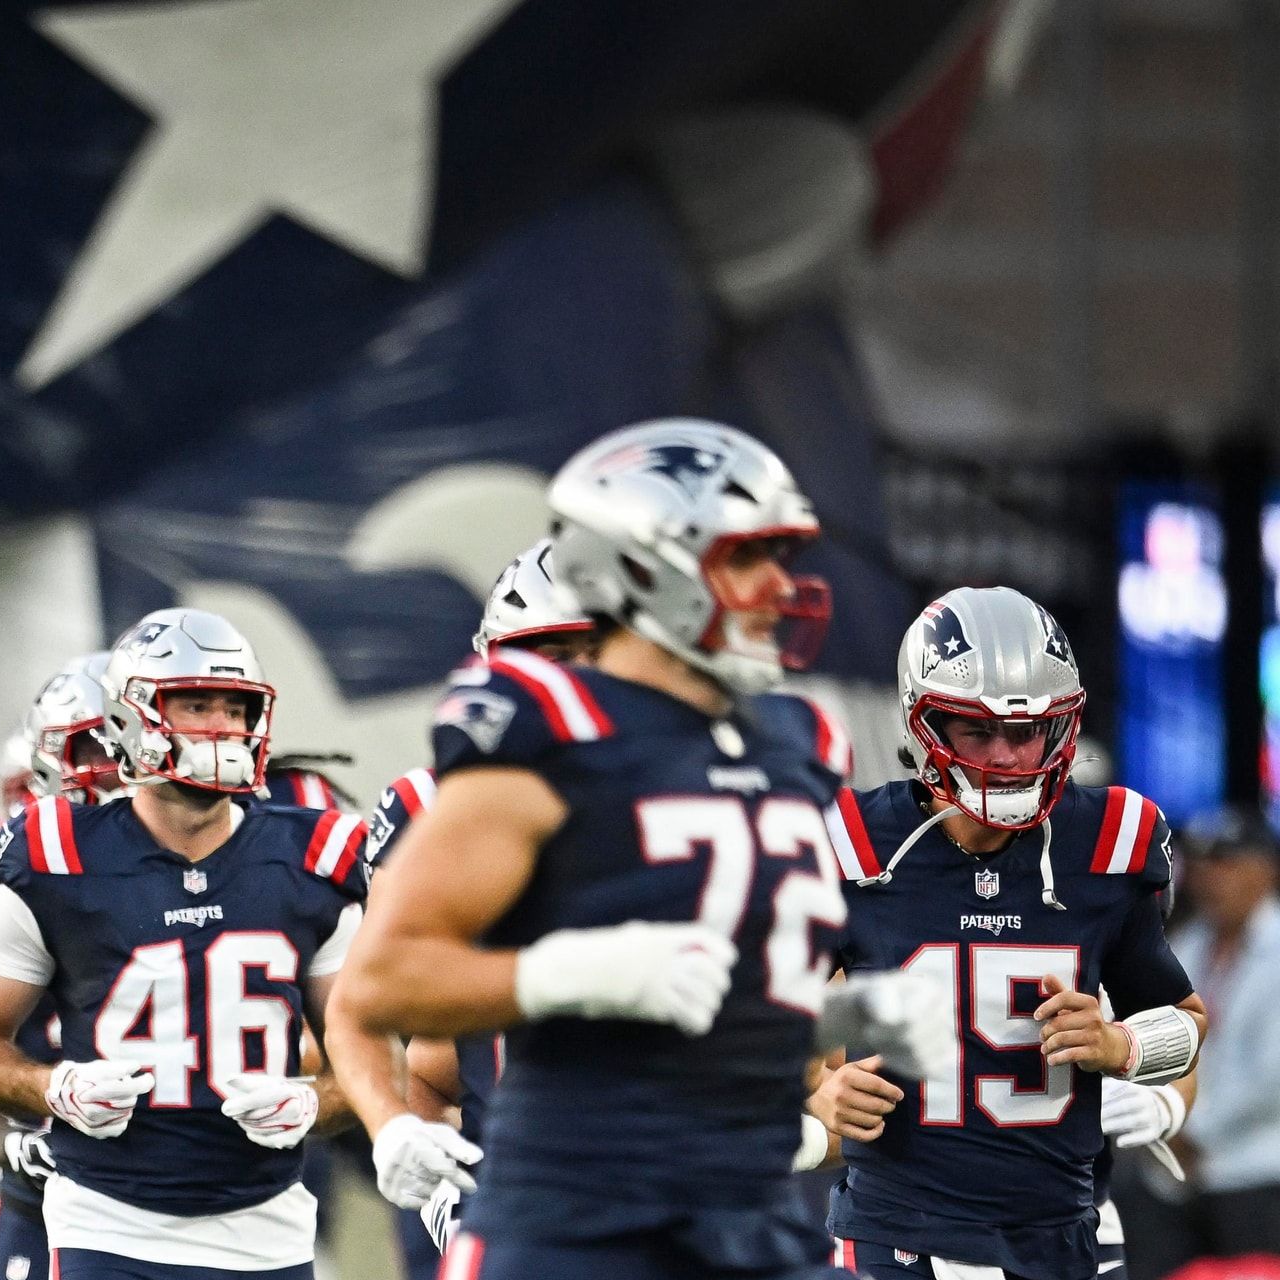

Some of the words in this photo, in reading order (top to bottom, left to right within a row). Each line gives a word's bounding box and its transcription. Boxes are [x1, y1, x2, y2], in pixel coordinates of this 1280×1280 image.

[164, 905, 224, 926] PATRIOTS
[633, 795, 848, 1019] 72
[960, 915, 1022, 930] PATRIOTS
[979, 882, 996, 893] NFL
[95, 930, 299, 1108] 46
[900, 943, 1081, 1128] 15
